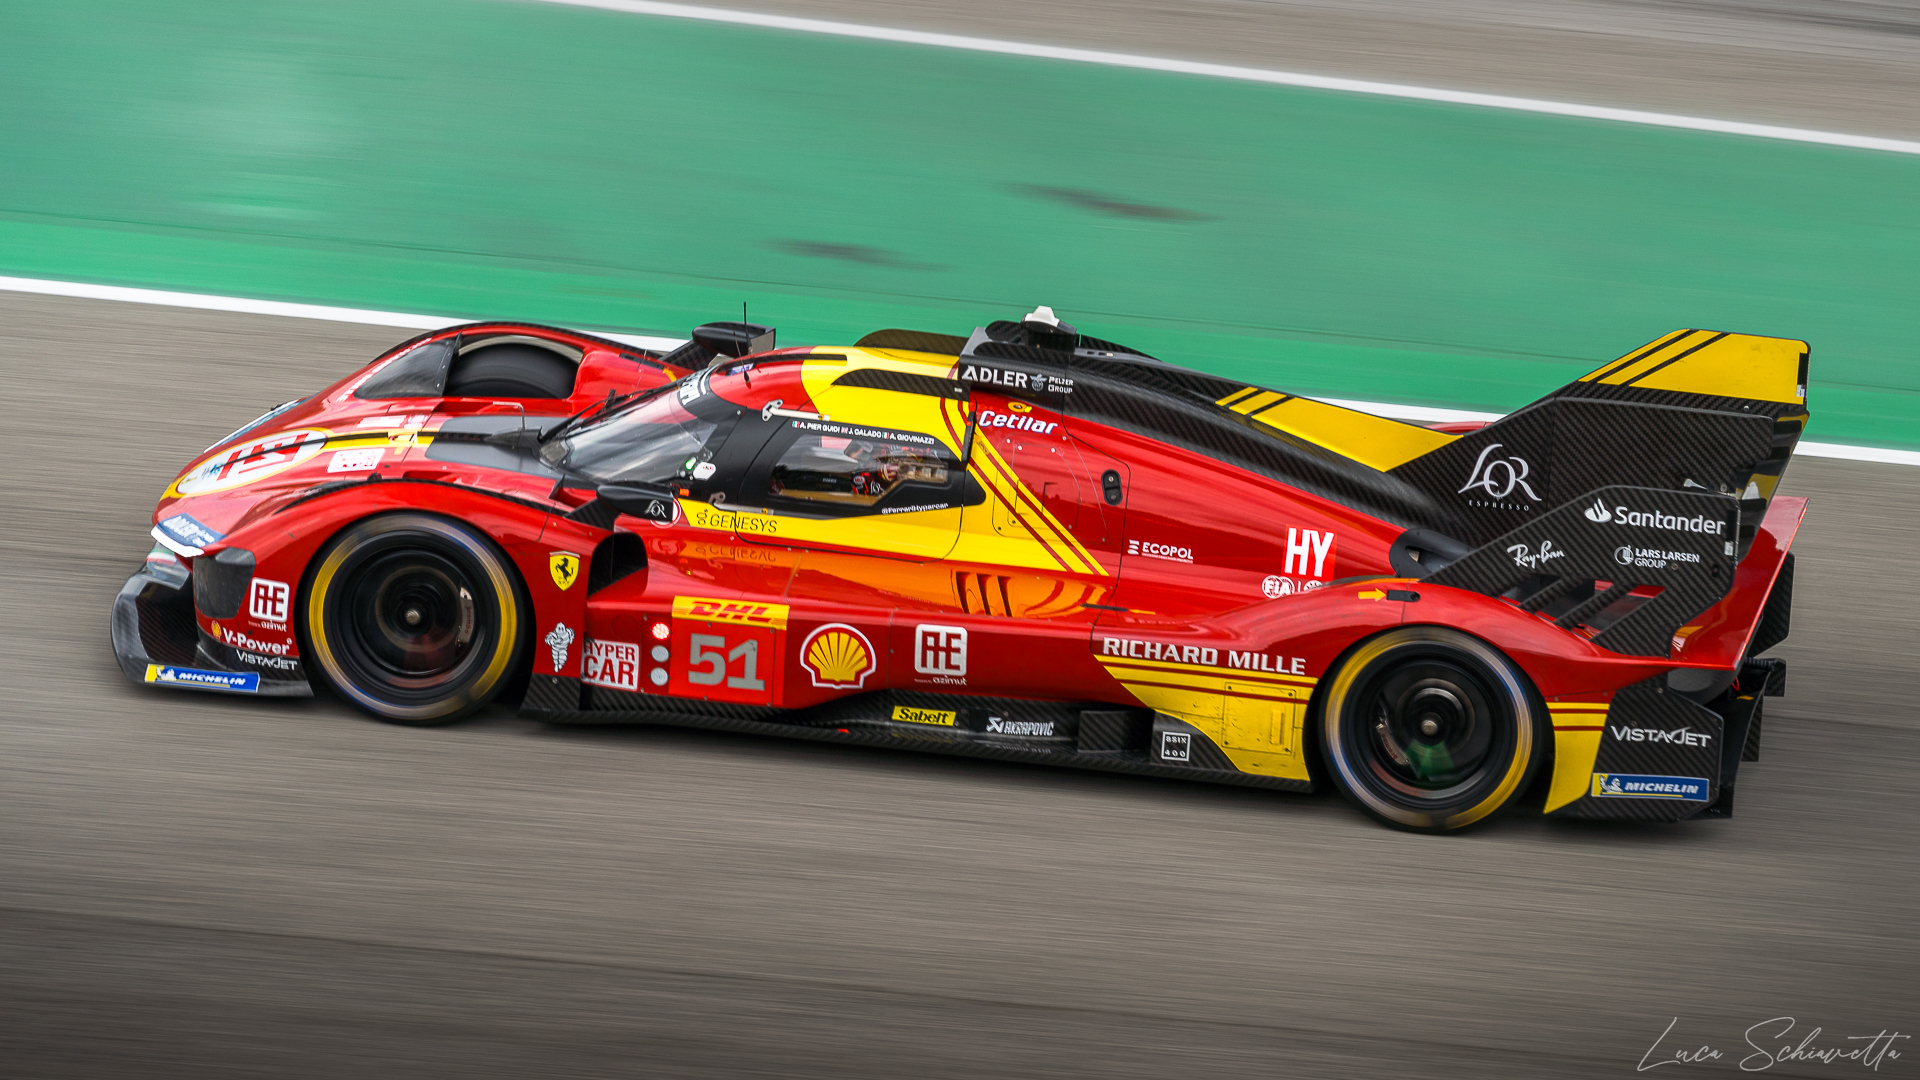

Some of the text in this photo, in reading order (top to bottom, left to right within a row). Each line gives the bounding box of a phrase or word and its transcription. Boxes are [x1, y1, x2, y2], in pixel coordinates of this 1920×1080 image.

[962, 365, 1027, 388] ADLER
[978, 410, 1058, 435] Cetilar
[823, 425, 840, 433] GUIDI
[854, 428, 881, 438] CALADO
[897, 433, 934, 445] GIOVINAZZI
[1468, 500, 1530, 512] ESPRESSO
[710, 514, 778, 533] GENESYS
[1614, 506, 1726, 535] Santander
[1142, 541, 1194, 560] ECOPOL
[1284, 527, 1334, 578] HY
[1635, 547, 1700, 563] LARS LARSEN
[1634, 557, 1667, 569] GROUP
[688, 600, 774, 624] DHL
[261, 620, 287, 632] azimut
[223, 627, 291, 655] V-Power
[583, 641, 636, 662] HYPER
[236, 649, 297, 670] VISTAJET
[688, 633, 766, 691] 51
[1102, 637, 1306, 675] RICHARD MILLE
[178, 672, 246, 686] MICHELIN
[583, 655, 635, 686] CAR
[932, 675, 967, 686] azimut
[898, 708, 949, 724] Sabelt
[1610, 725, 1712, 747] VISTAJET
[1624, 782, 1699, 794] MICHELIN
